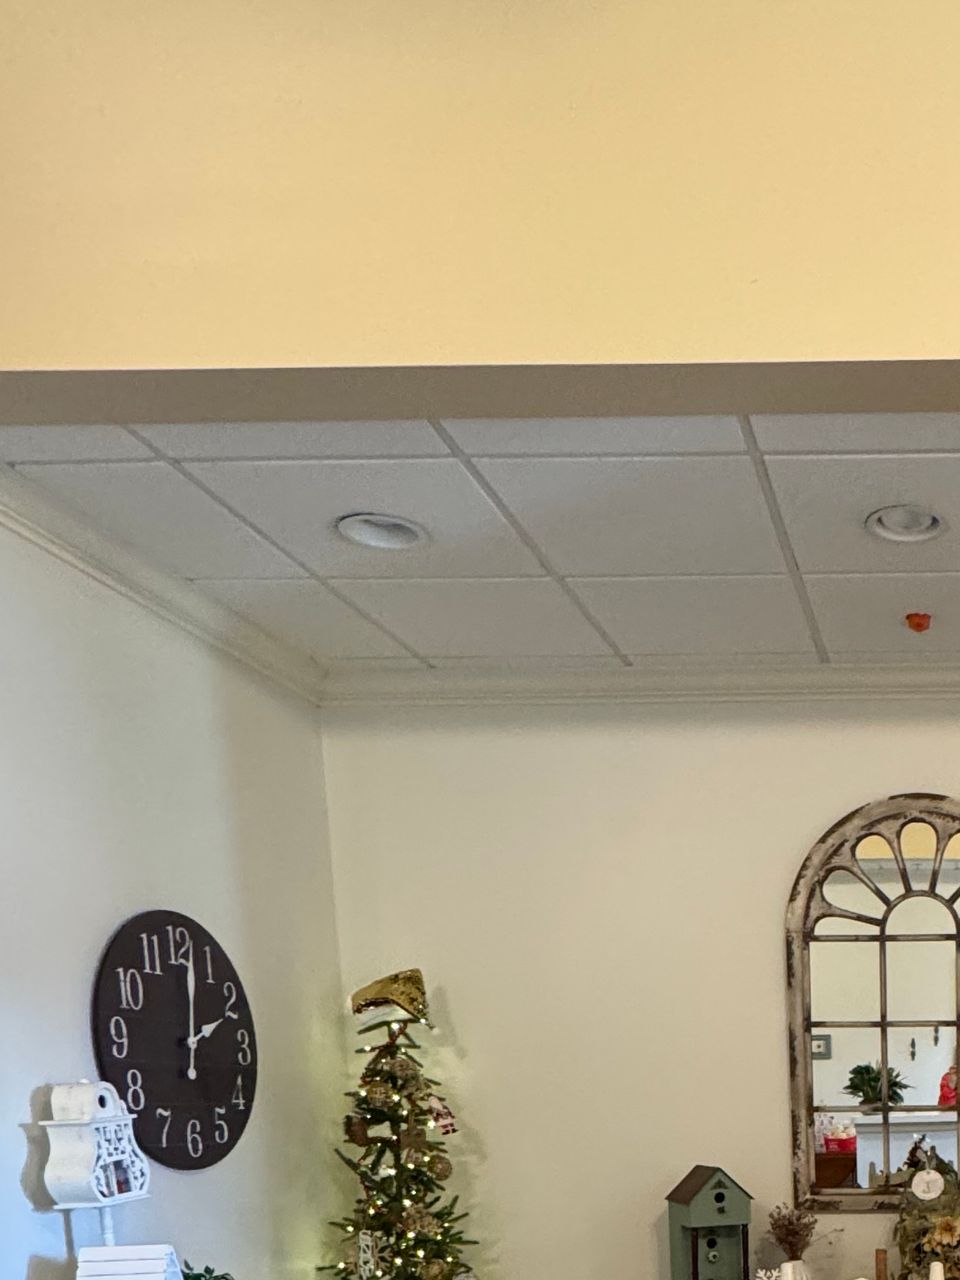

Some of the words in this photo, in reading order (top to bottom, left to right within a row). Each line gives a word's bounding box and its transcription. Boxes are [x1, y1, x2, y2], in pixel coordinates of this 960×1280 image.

[140, 933, 163, 976] 11
[166, 925, 191, 967] 12
[203, 946, 215, 983] 1
[116, 967, 144, 1011] 10
[223, 982, 238, 1020] 2
[110, 1016, 128, 1058] 9
[236, 1029, 251, 1066] 3
[127, 1069, 145, 1111] 8
[231, 1074, 246, 1110] 4
[156, 1107, 171, 1148] 7
[187, 1119, 202, 1158] 6
[214, 1105, 228, 1144] 5
